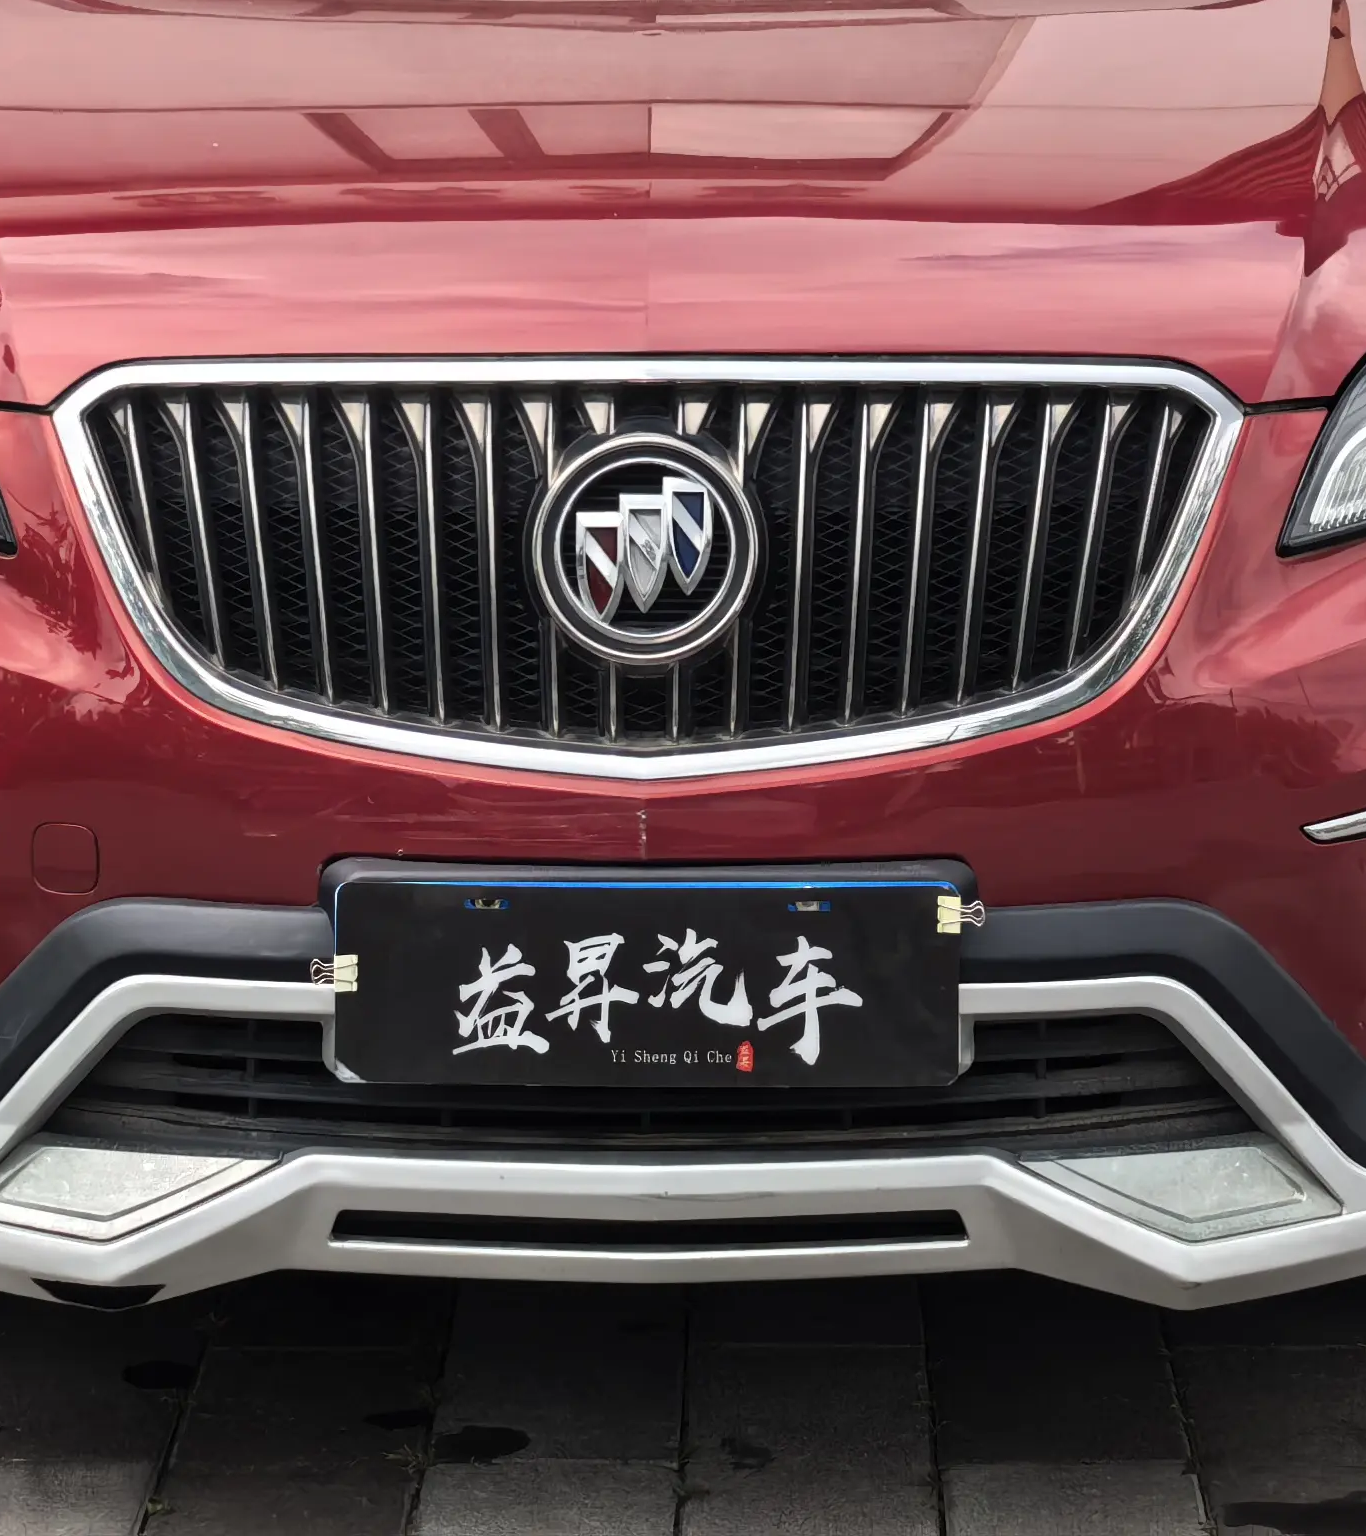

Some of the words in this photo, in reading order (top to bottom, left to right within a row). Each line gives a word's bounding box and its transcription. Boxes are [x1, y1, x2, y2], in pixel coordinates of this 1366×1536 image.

[610, 1049, 626, 1063] Yi
[634, 1049, 677, 1064] Sheng
[683, 1050, 699, 1063] Qi
[707, 1050, 732, 1063] Che
